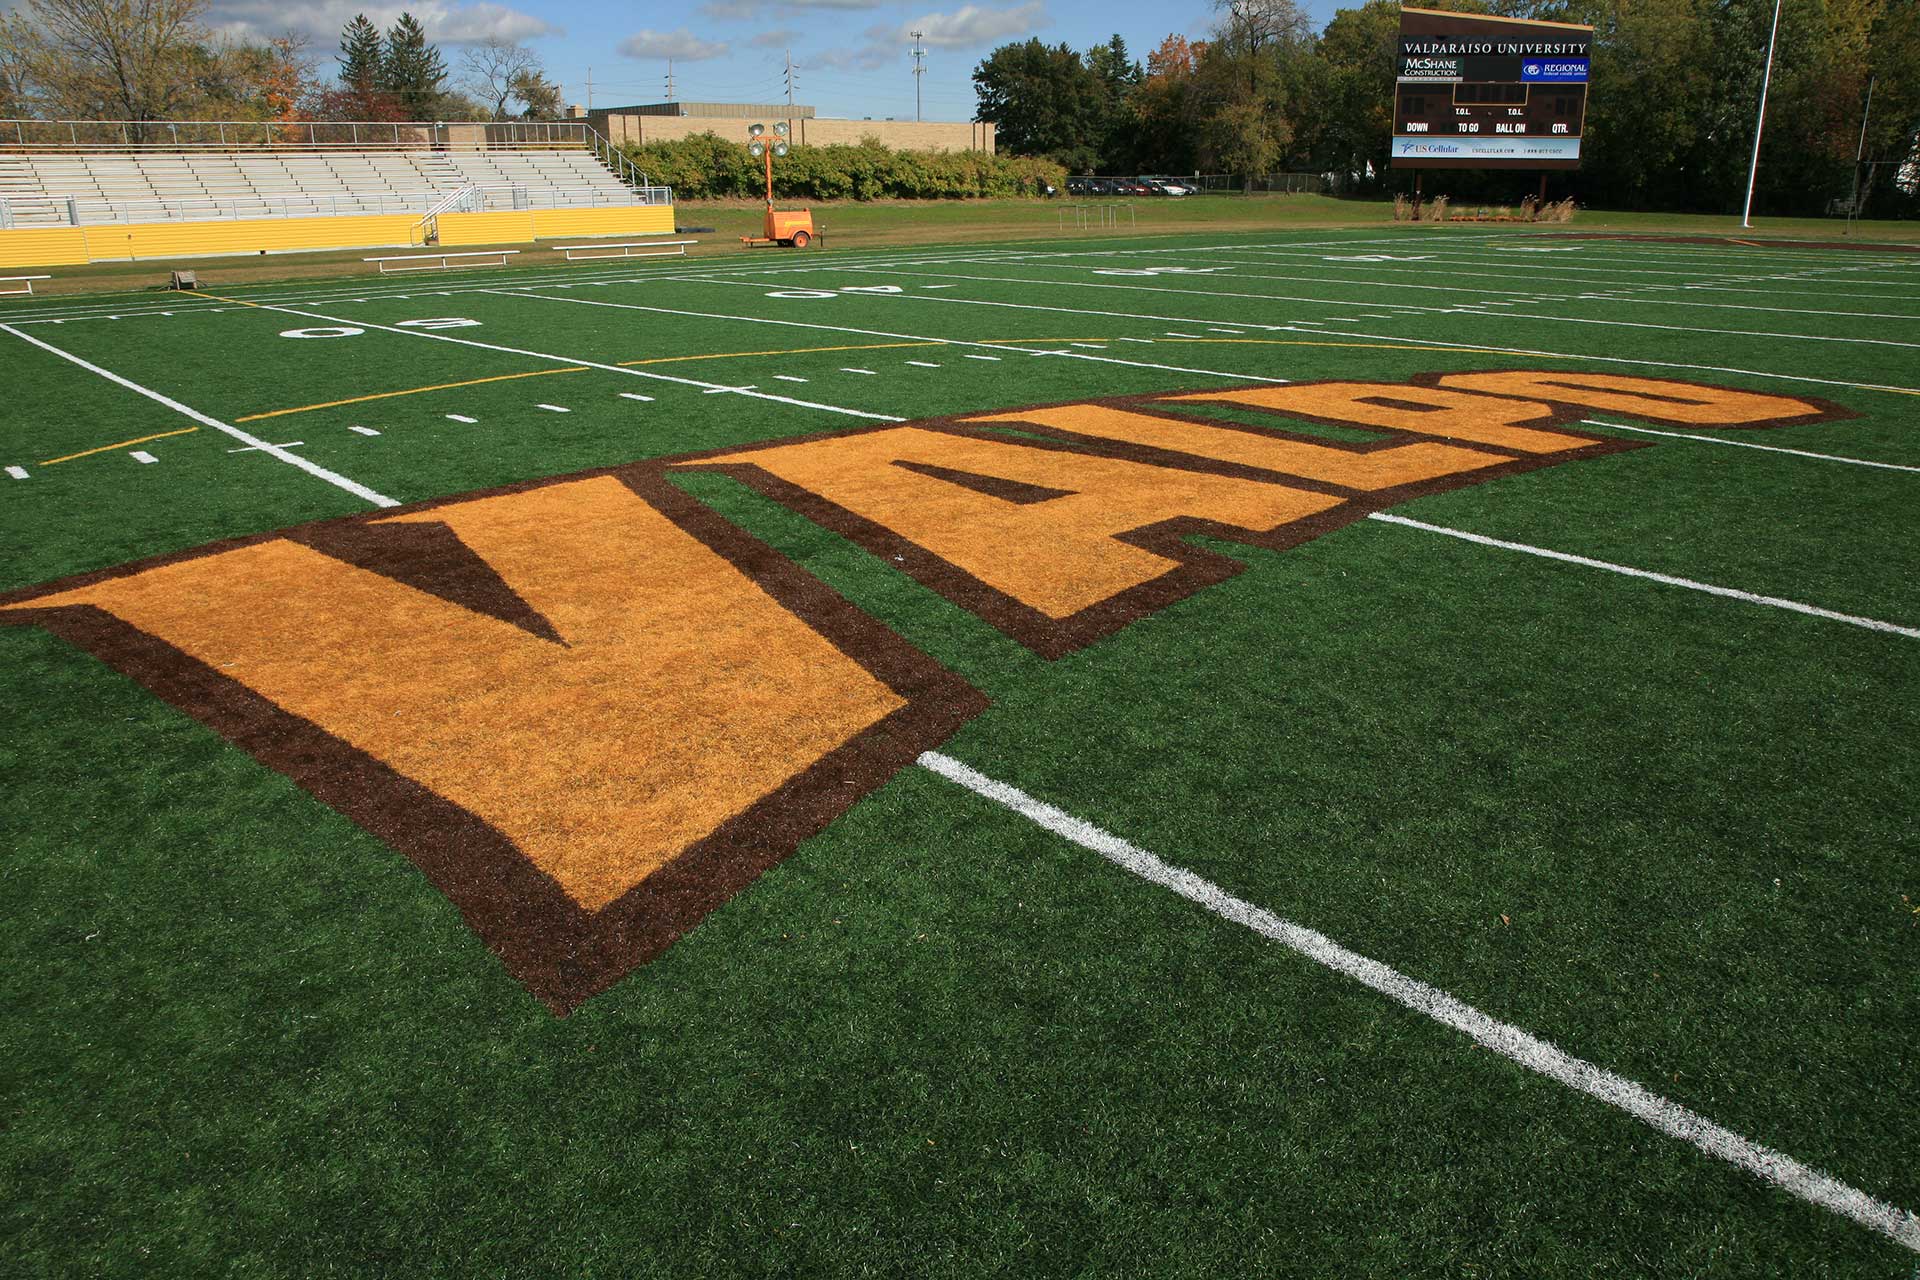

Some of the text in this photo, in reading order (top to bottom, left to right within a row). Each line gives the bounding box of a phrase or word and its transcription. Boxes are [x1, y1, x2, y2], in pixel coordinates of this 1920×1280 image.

[1405, 43, 1587, 54] VALPARAISO UNIVERSITY
[1544, 64, 1587, 72] REGIONAL
[1406, 122, 1428, 132] DOWN
[1458, 123, 1479, 132] TO GO
[1496, 123, 1526, 133] BALL ON
[1552, 123, 1568, 134] QTR.
[0, 370, 1858, 1014] VALPO
